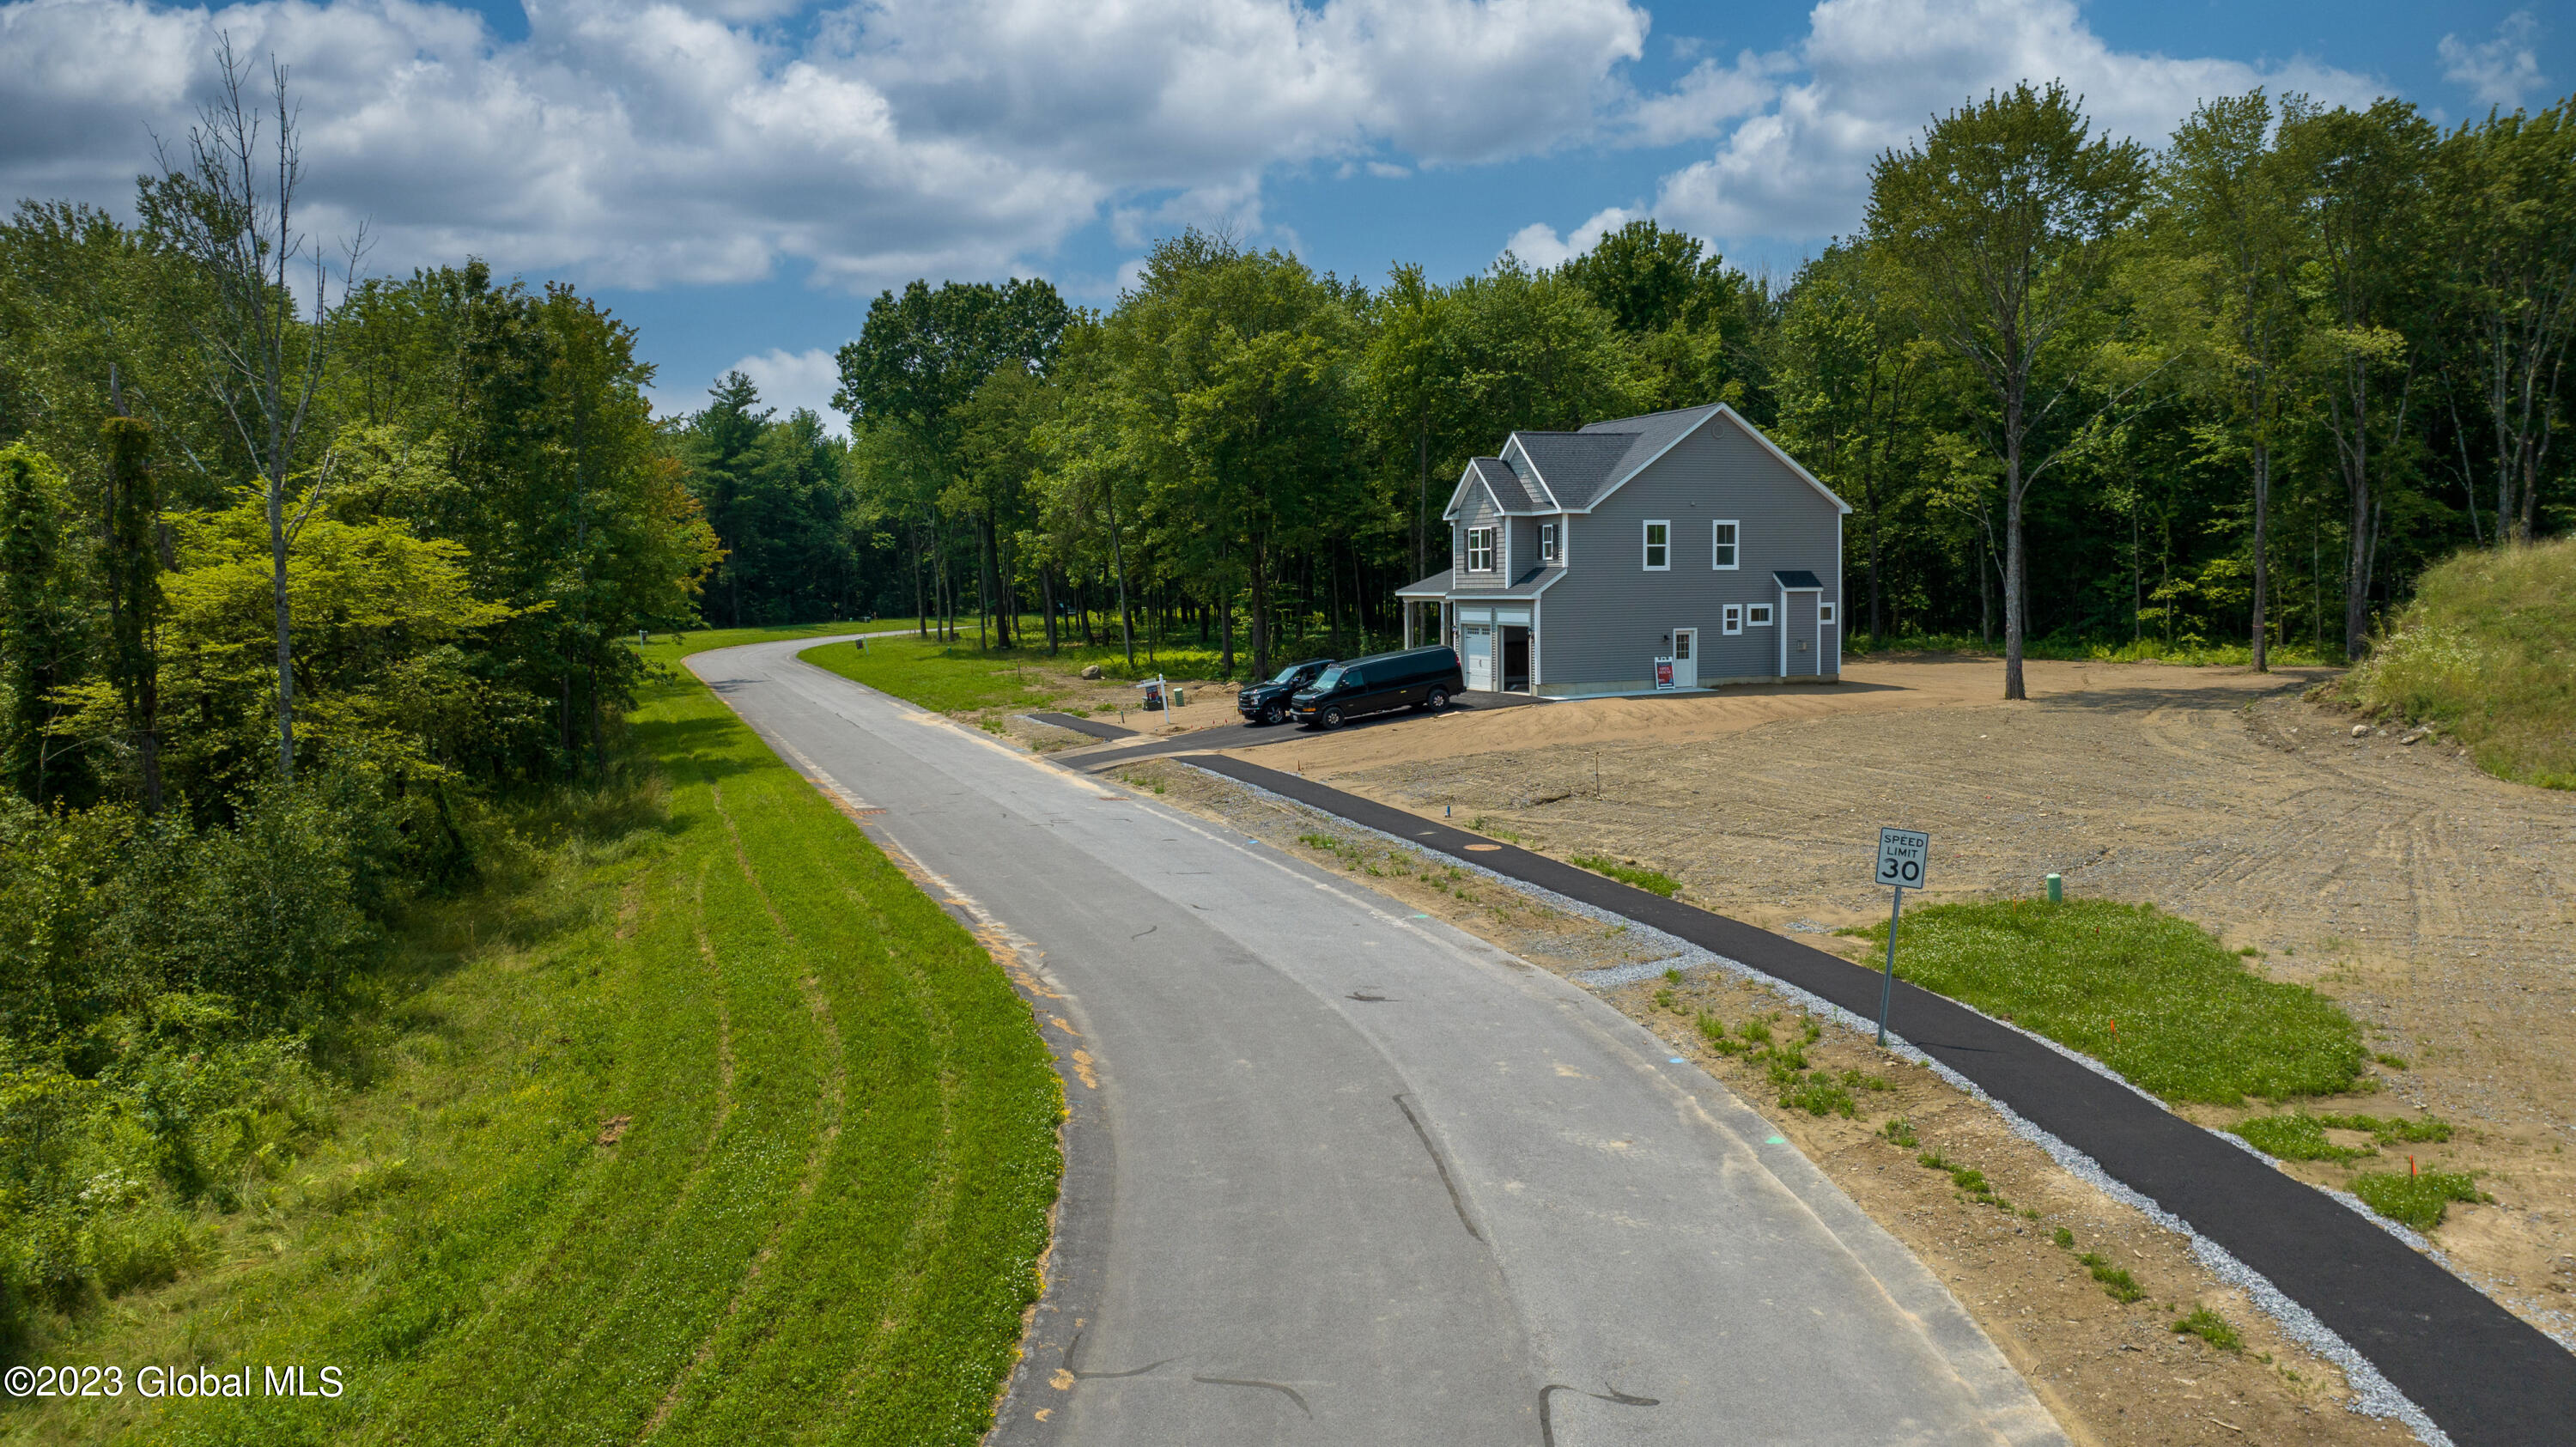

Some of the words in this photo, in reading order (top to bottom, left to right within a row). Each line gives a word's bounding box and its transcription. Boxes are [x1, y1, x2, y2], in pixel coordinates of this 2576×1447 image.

[1884, 835, 1924, 848] SPEED
[1886, 847, 1918, 858] LIMIT
[1881, 858, 1919, 881] 30
